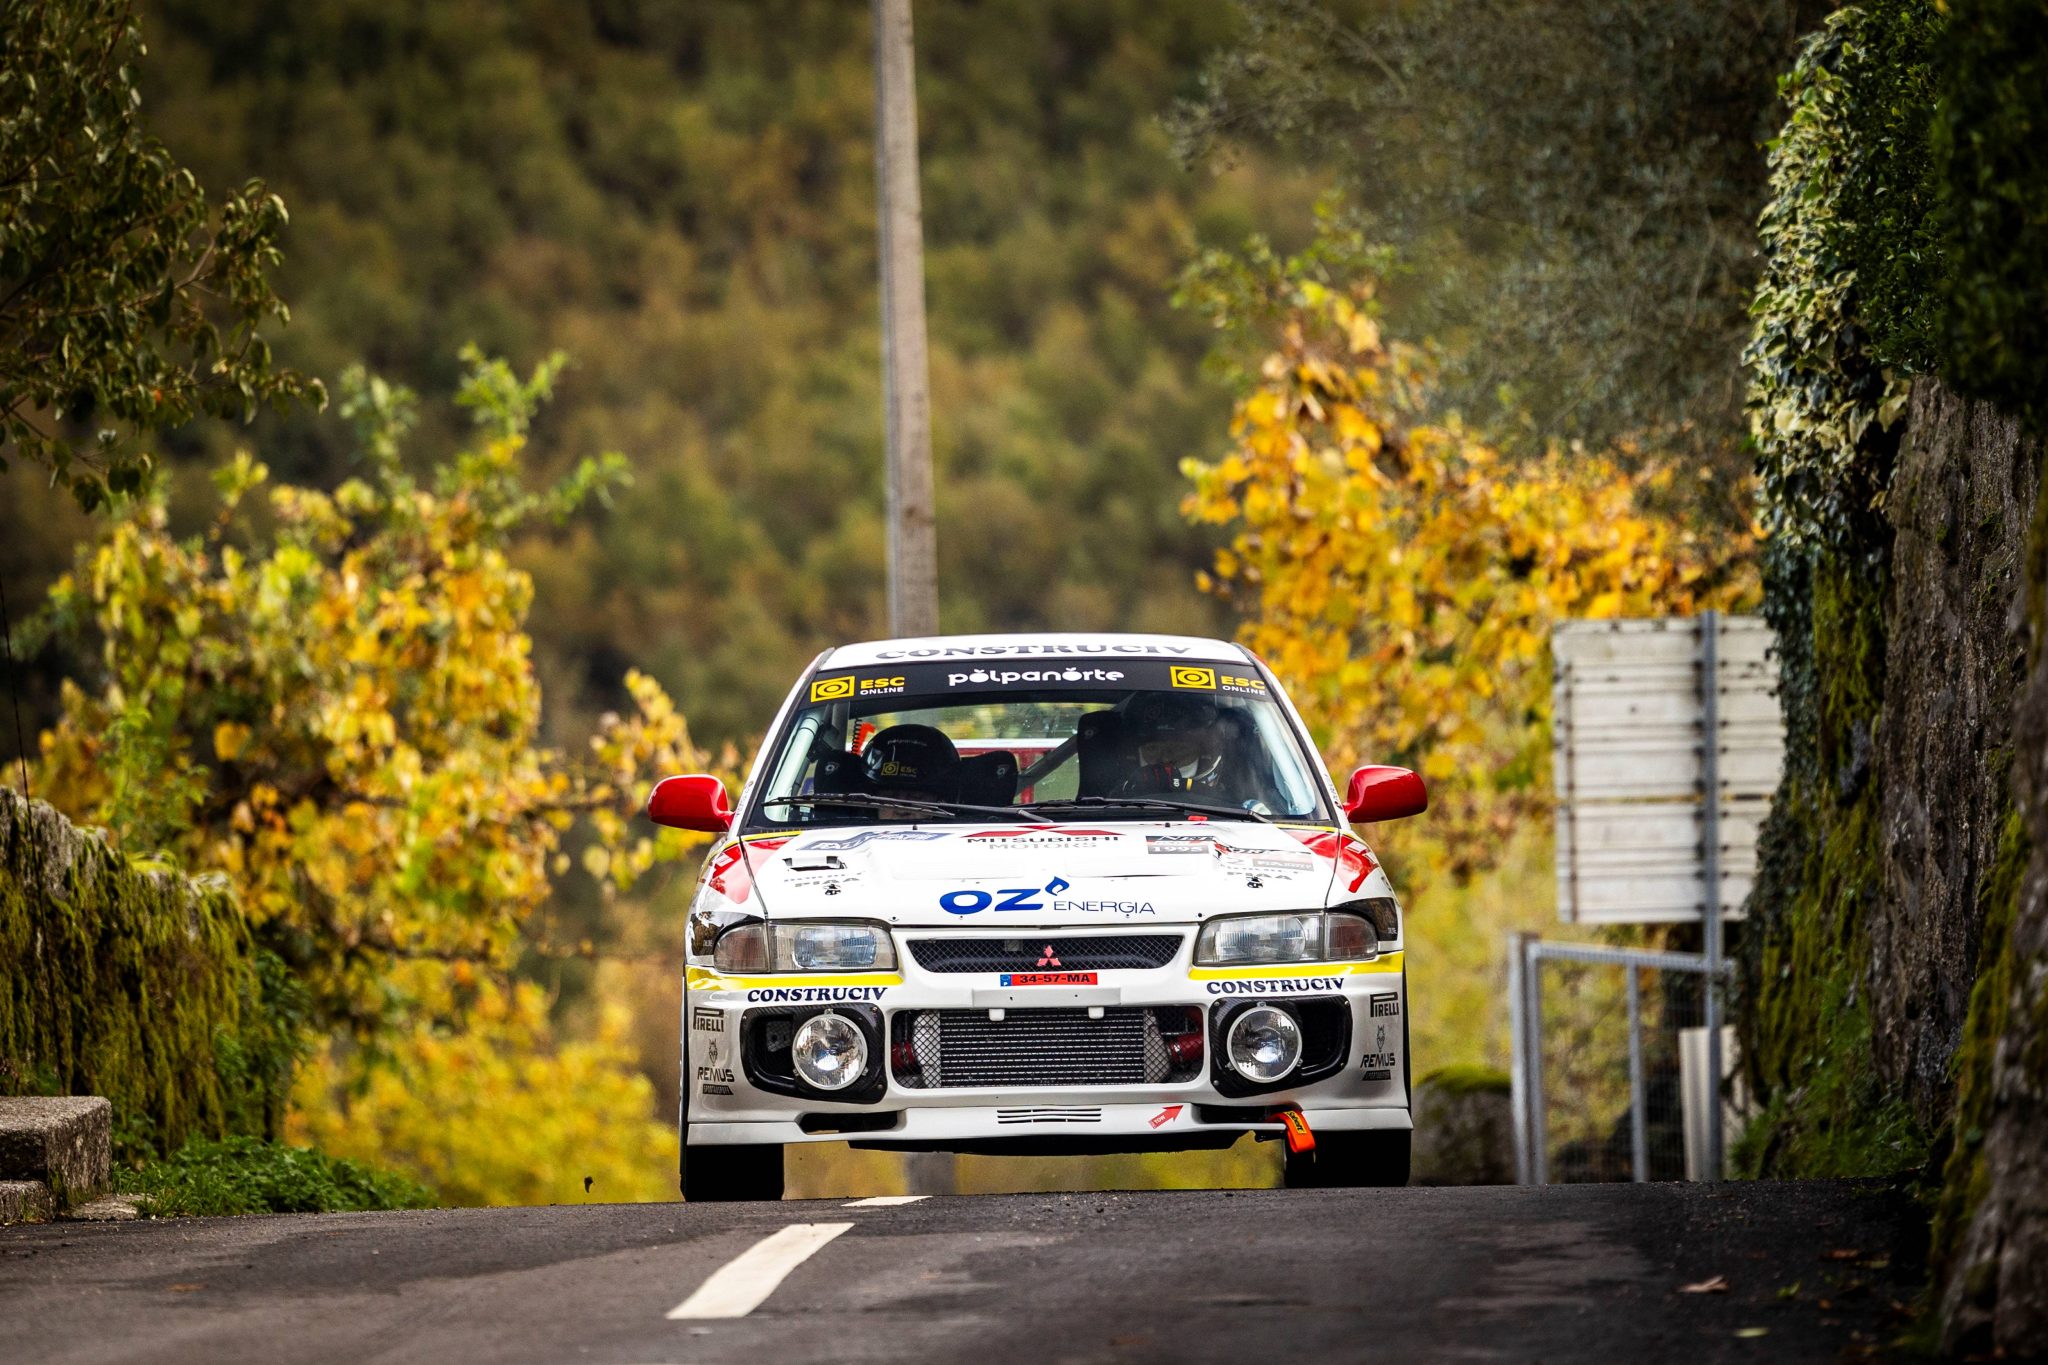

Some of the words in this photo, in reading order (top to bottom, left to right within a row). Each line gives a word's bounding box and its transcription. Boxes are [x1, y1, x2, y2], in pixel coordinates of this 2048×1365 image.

[876, 644, 1192, 660] CONSTRUCIV
[860, 676, 905, 690] ESC
[1220, 675, 1265, 690] ESC
[1222, 684, 1266, 696] ONLINE
[860, 686, 904, 696] ONLINE
[939, 888, 1044, 915] OZ
[1053, 900, 1156, 915] ENERGIA
[1019, 974, 1090, 984] 34-57-MA
[1206, 977, 1345, 995] CONSTRUCIV
[747, 987, 888, 1003] CONSTRUCIV
[1370, 991, 1399, 1017] PIRELLI
[693, 1006, 725, 1033] PIRELLI
[1360, 1052, 1396, 1070] REMUS
[697, 1066, 735, 1083] REMUS
